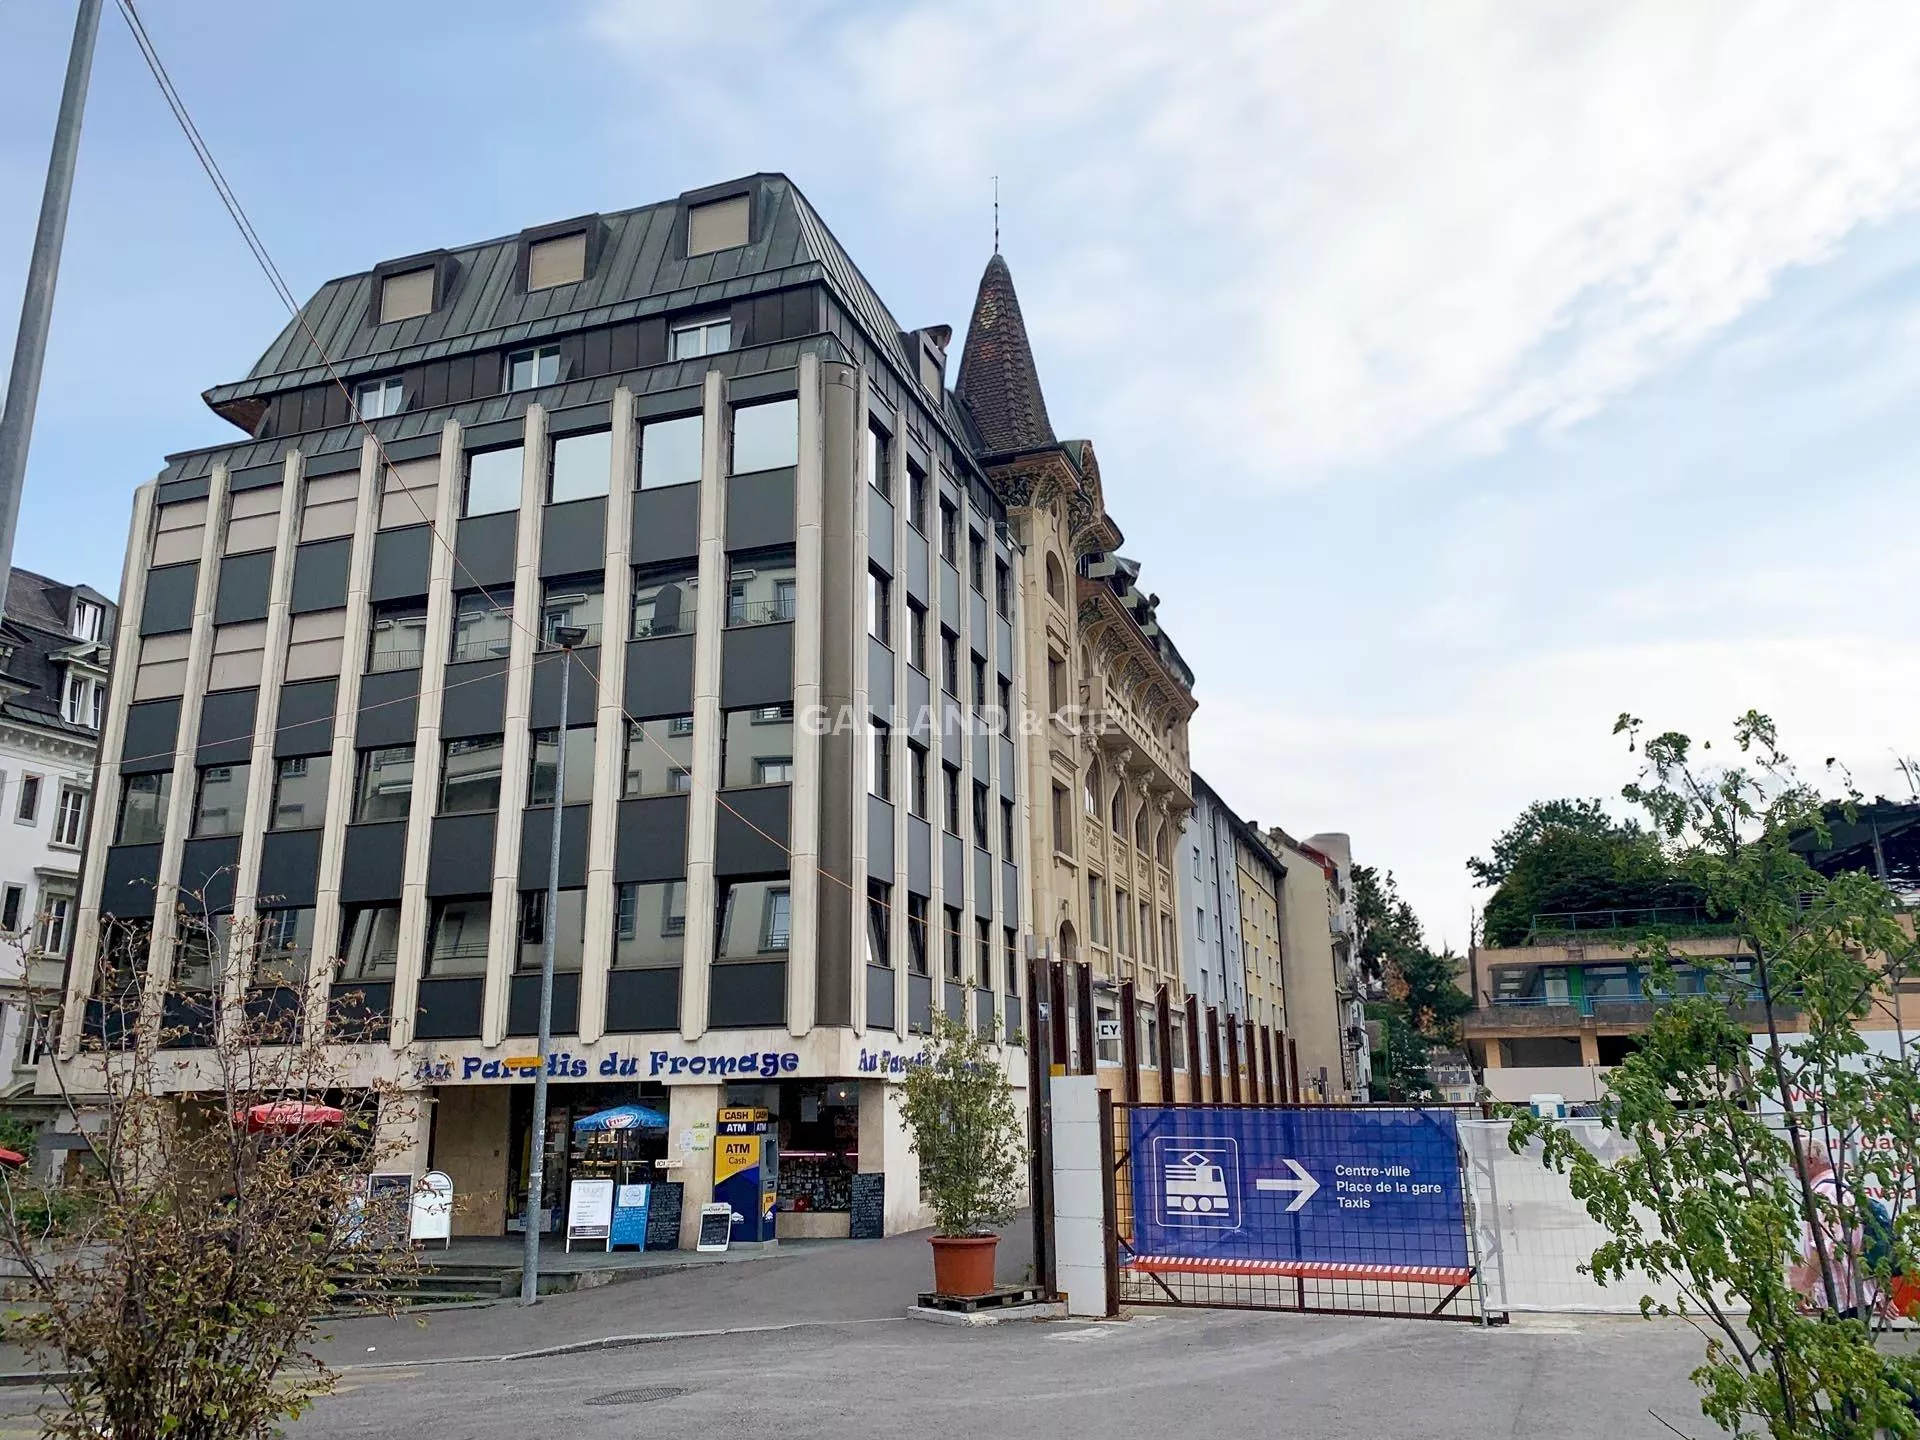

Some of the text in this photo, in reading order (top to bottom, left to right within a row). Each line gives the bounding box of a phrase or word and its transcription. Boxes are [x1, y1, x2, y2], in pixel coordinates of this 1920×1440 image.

[1101, 1024, 1118, 1036] CY
[600, 1051, 638, 1076] du
[649, 1050, 799, 1077] Fromage
[858, 1048, 878, 1073] Au
[724, 1111, 749, 1120] CASH
[726, 1123, 747, 1133] ATM
[725, 1143, 751, 1154] ATM
[728, 1156, 747, 1165] Cash
[1335, 1164, 1411, 1177] Centre-ville
[1336, 1180, 1442, 1196] Place de la gare
[1336, 1196, 1371, 1209] Taxis
